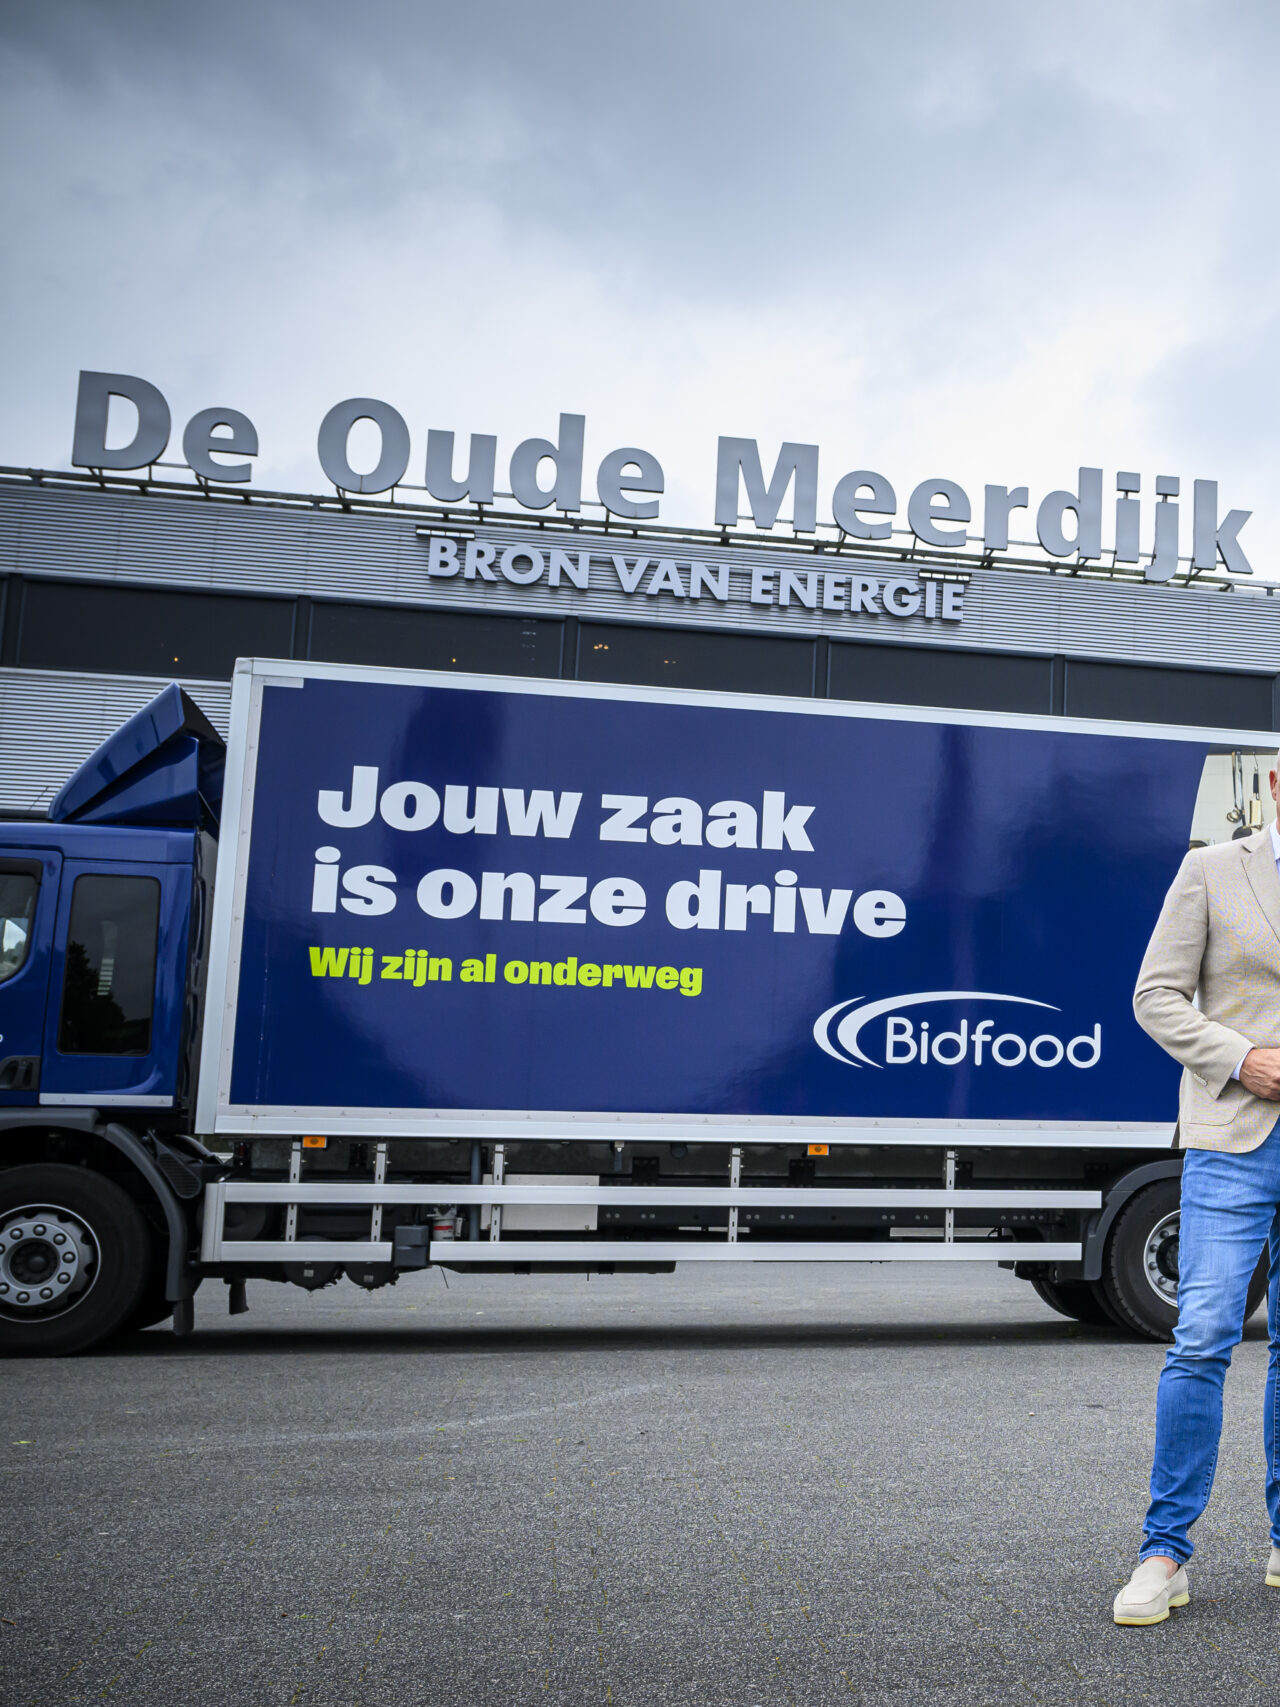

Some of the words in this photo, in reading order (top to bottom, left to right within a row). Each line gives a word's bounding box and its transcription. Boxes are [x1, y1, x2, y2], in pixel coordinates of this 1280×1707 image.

[72, 370, 259, 483] De
[317, 397, 665, 519] Oude
[715, 436, 1254, 583] Meerdijk
[427, 537, 592, 589] BRON
[611, 555, 730, 601] VAN
[750, 567, 965, 620] ENERGIE
[317, 765, 583, 839] Jouw
[599, 790, 816, 852] zaak
[311, 846, 397, 916] is
[416, 868, 647, 927] onze
[665, 869, 907, 938] drive
[308, 946, 375, 986] Wij
[380, 948, 453, 988] zijn
[459, 953, 497, 983] al
[503, 956, 703, 997] onderweg
[885, 1016, 1102, 1069] Bidfood
